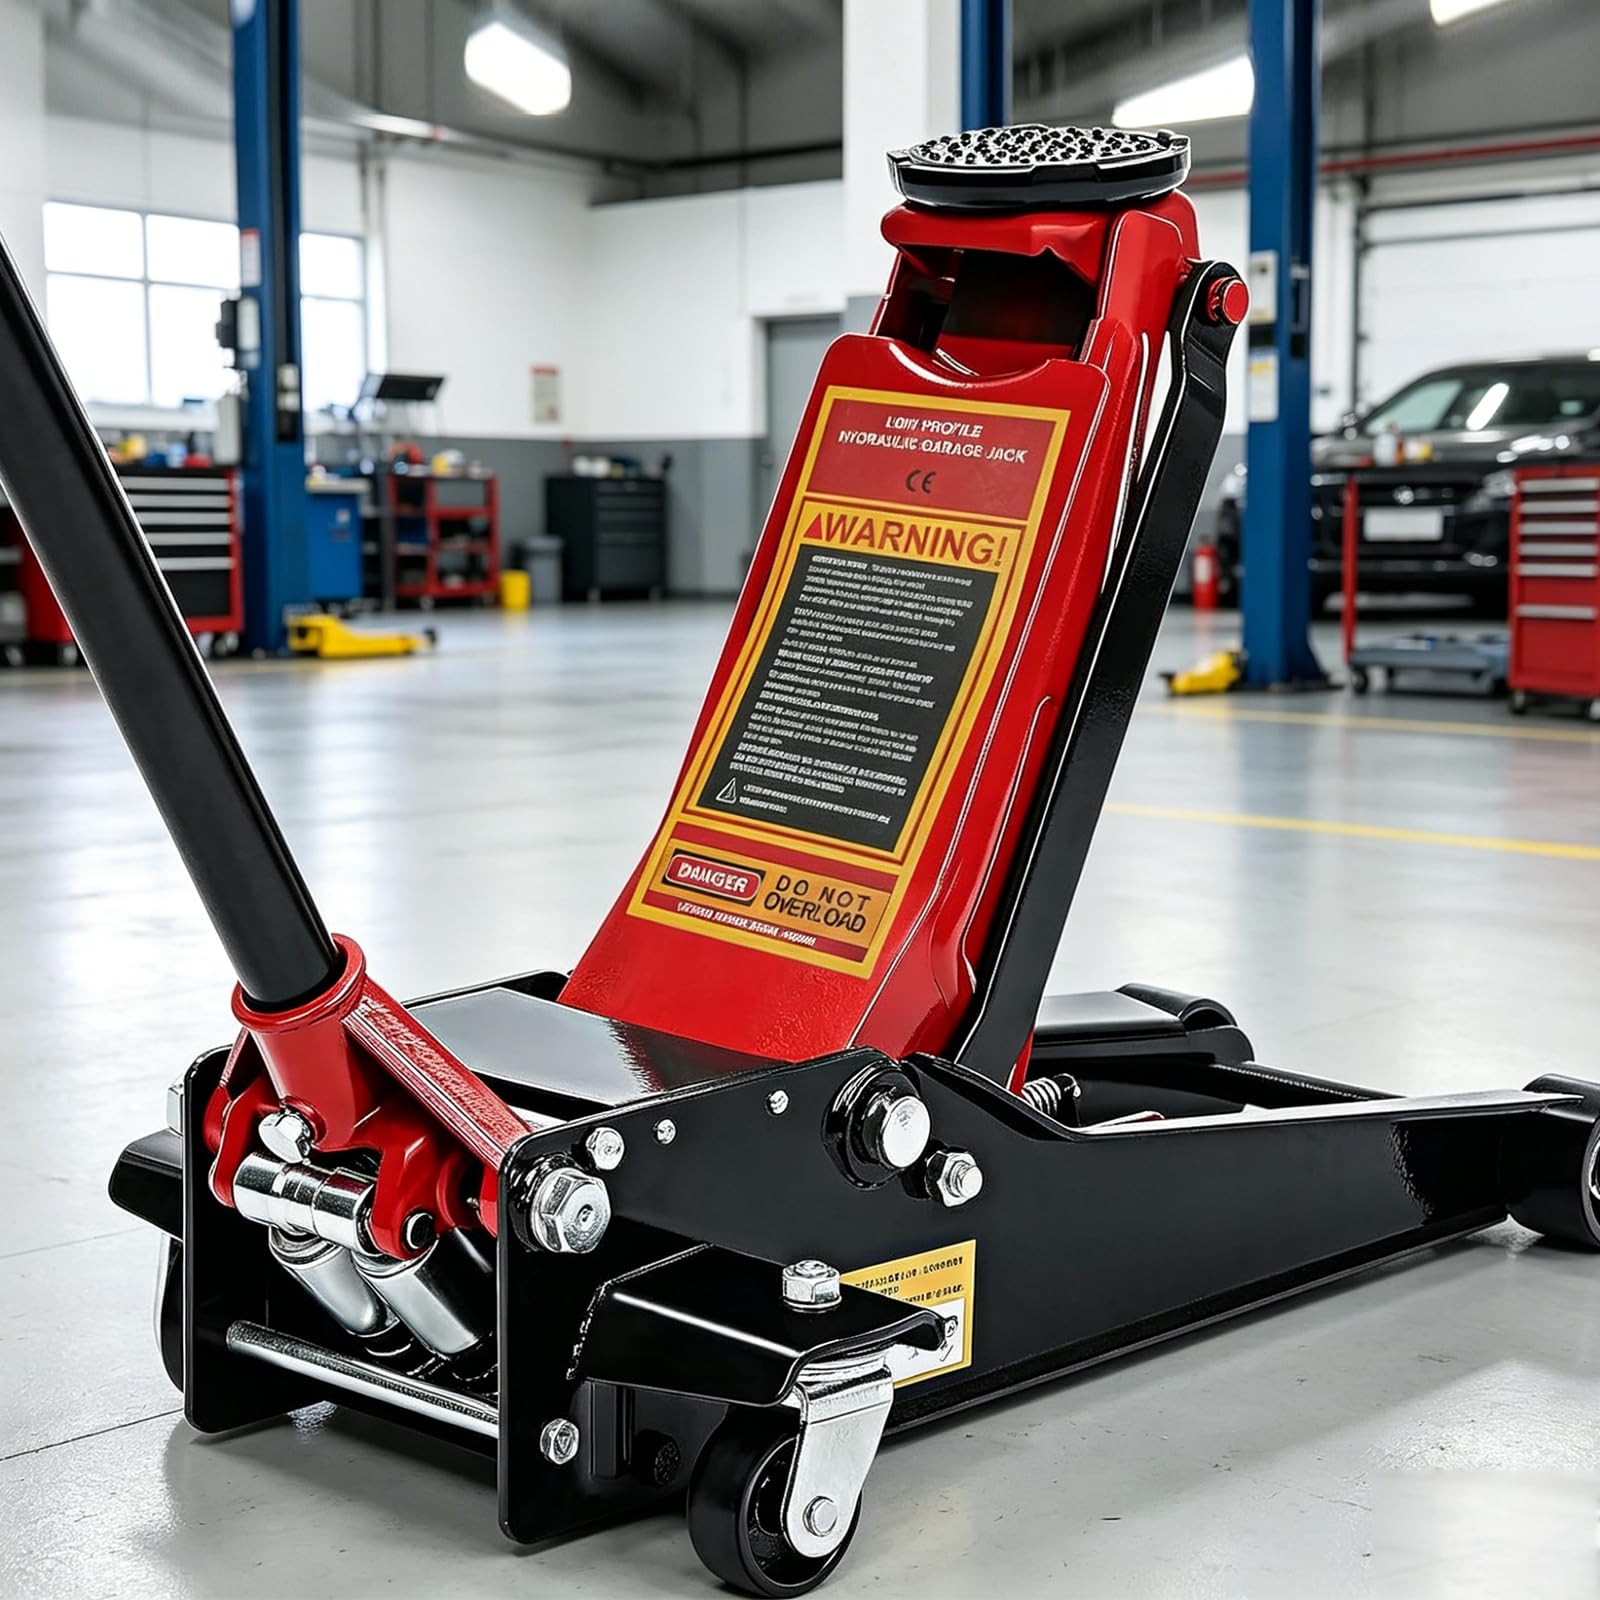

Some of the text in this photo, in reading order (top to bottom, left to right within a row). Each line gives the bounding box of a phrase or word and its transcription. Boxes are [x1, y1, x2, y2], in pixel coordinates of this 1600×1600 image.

[985, 446, 1028, 463] JACK
[825, 512, 1008, 567] WARNING!
[763, 891, 867, 933] OVERLOAD
[775, 874, 872, 911] DO NOT
